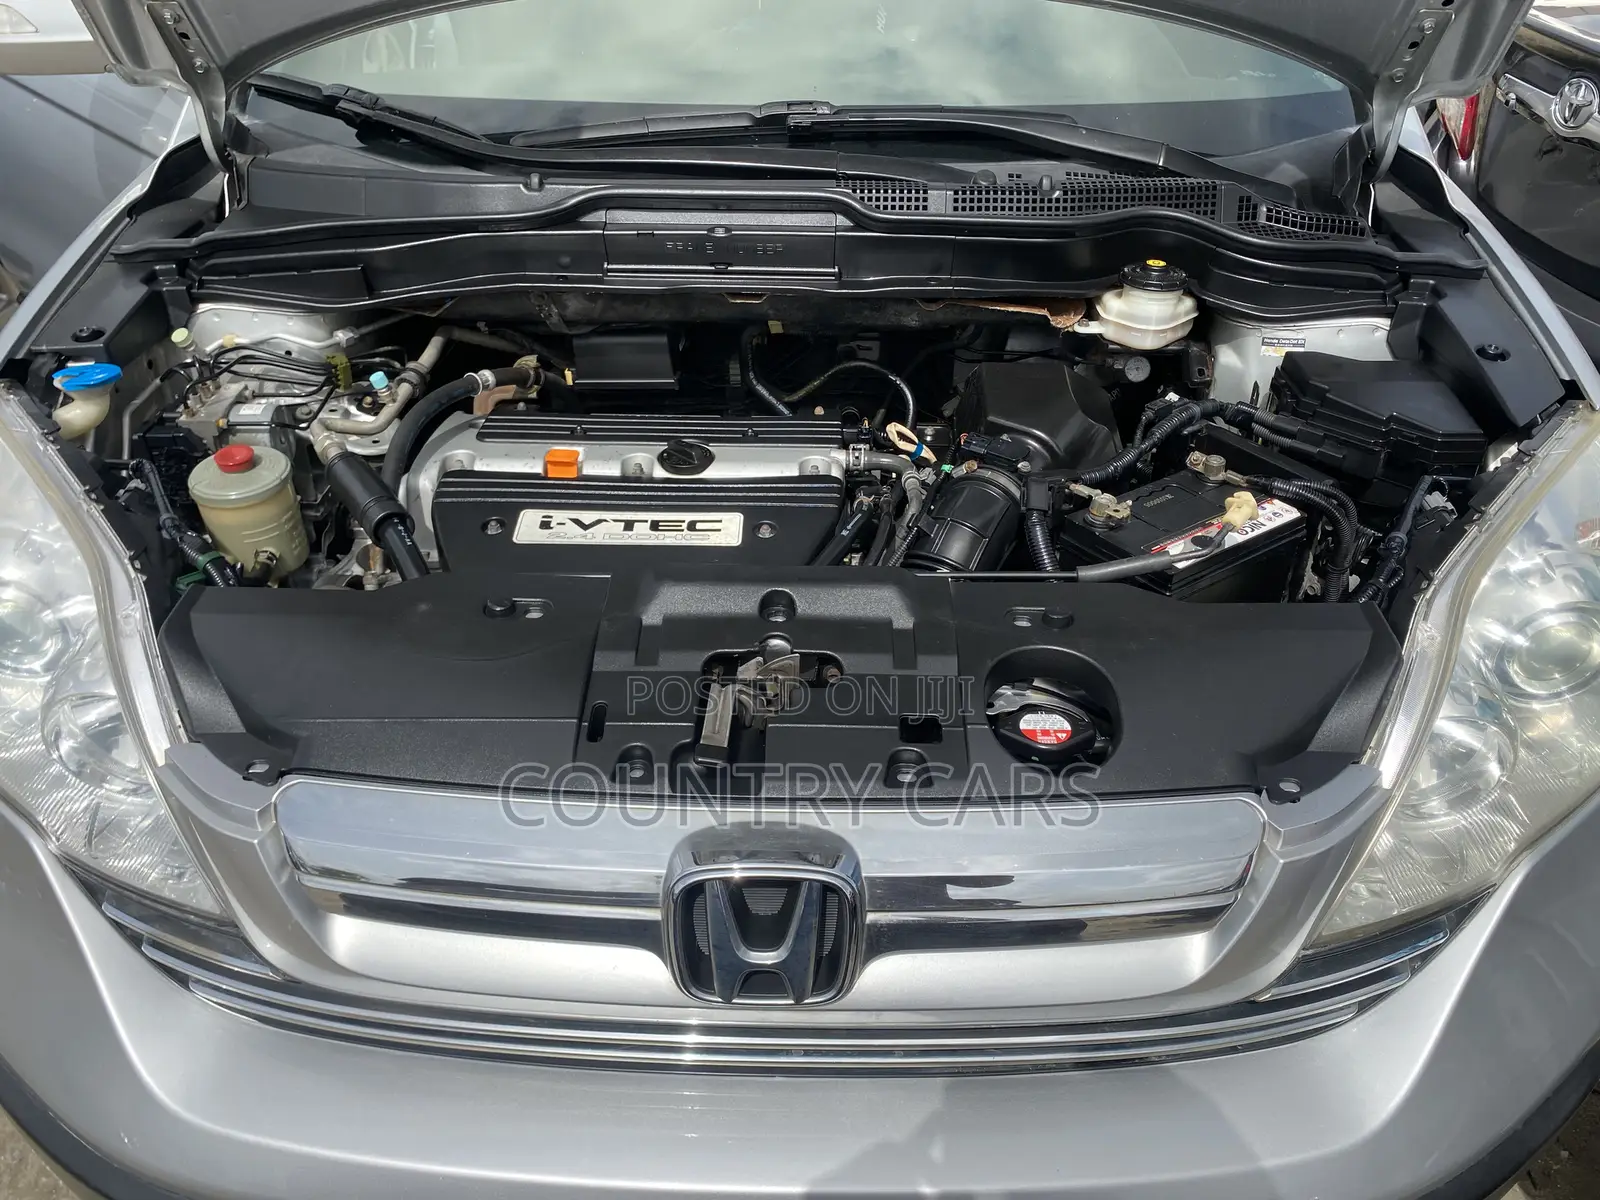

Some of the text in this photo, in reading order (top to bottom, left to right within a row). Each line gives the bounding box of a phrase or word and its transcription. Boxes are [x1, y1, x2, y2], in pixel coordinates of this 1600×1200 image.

[538, 514, 723, 532] i-VTEC
[546, 532, 711, 542] 2.4 DOHC
